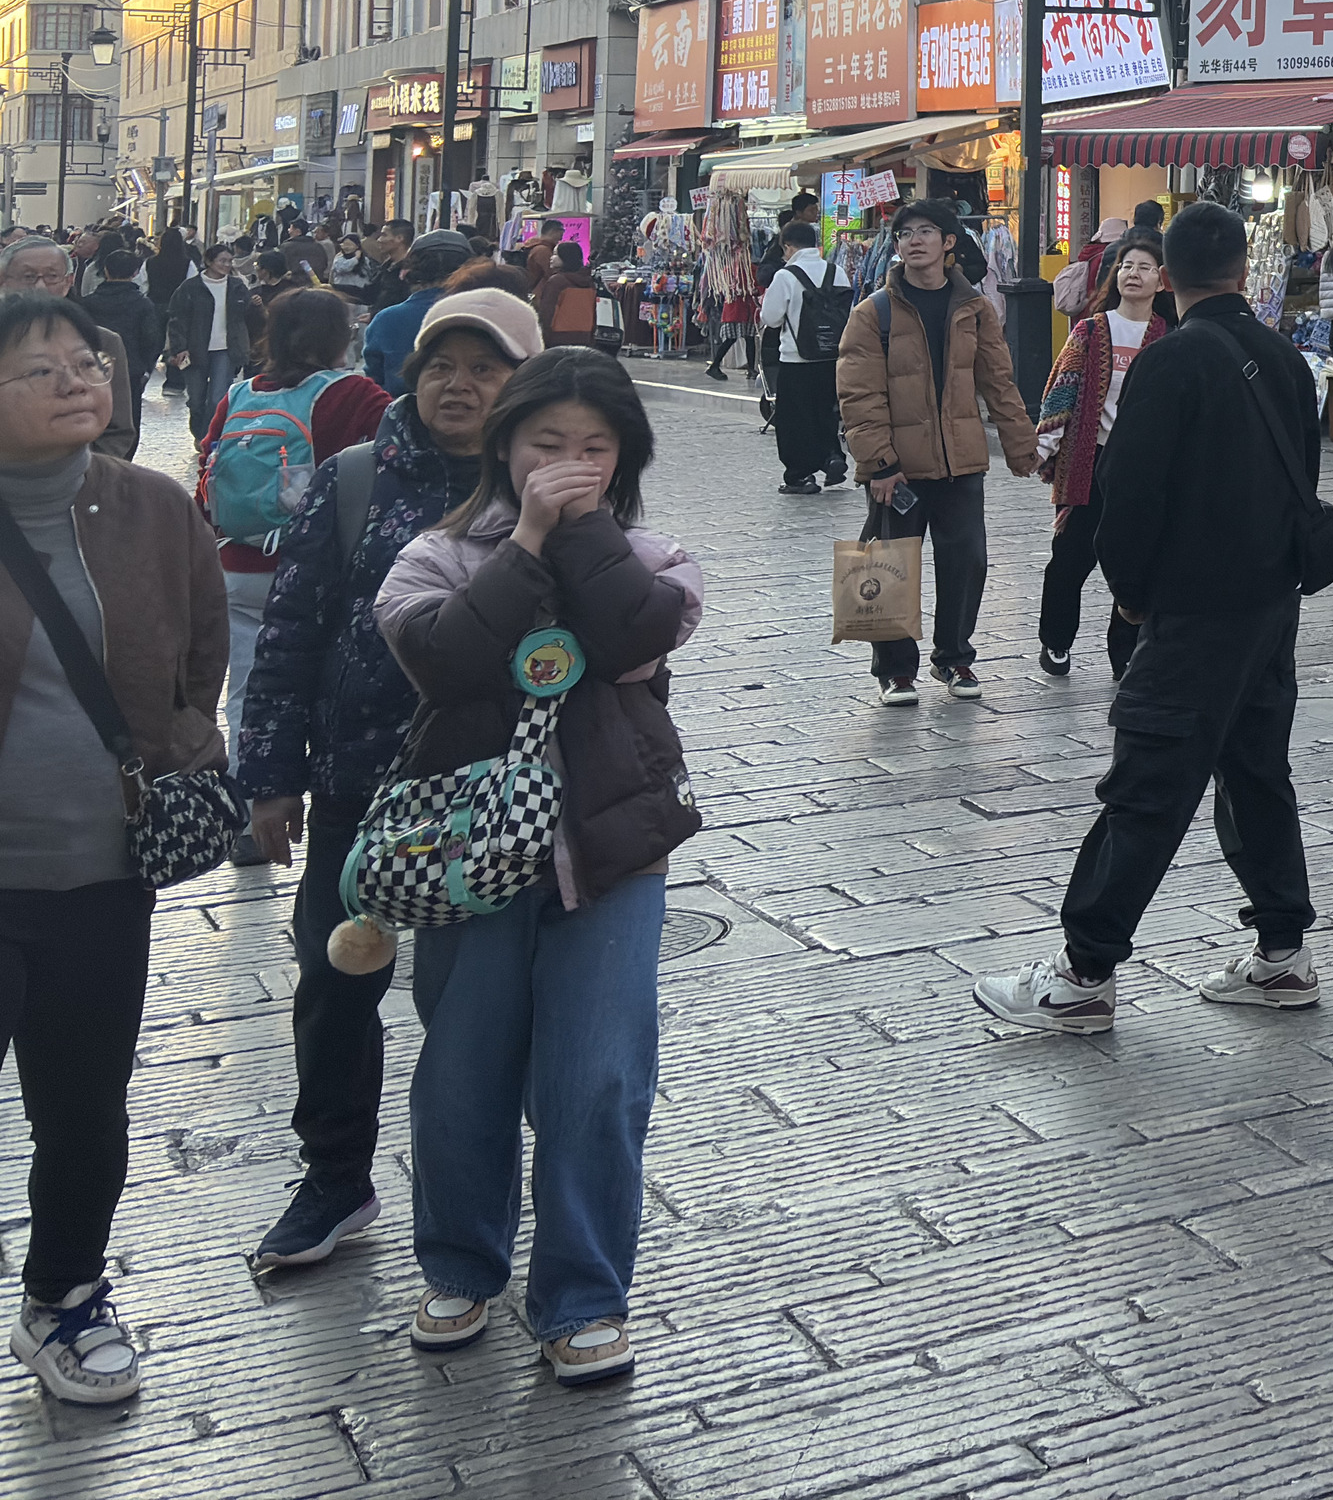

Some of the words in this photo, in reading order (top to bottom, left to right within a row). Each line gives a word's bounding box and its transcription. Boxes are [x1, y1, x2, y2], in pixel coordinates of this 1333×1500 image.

[652, 9, 693, 71] 云南
[824, 47, 888, 84] 三十年老店
[1199, 57, 1258, 74] 光华街44号
[722, 73, 744, 111] 服饰
[747, 70, 769, 109] 饰品
